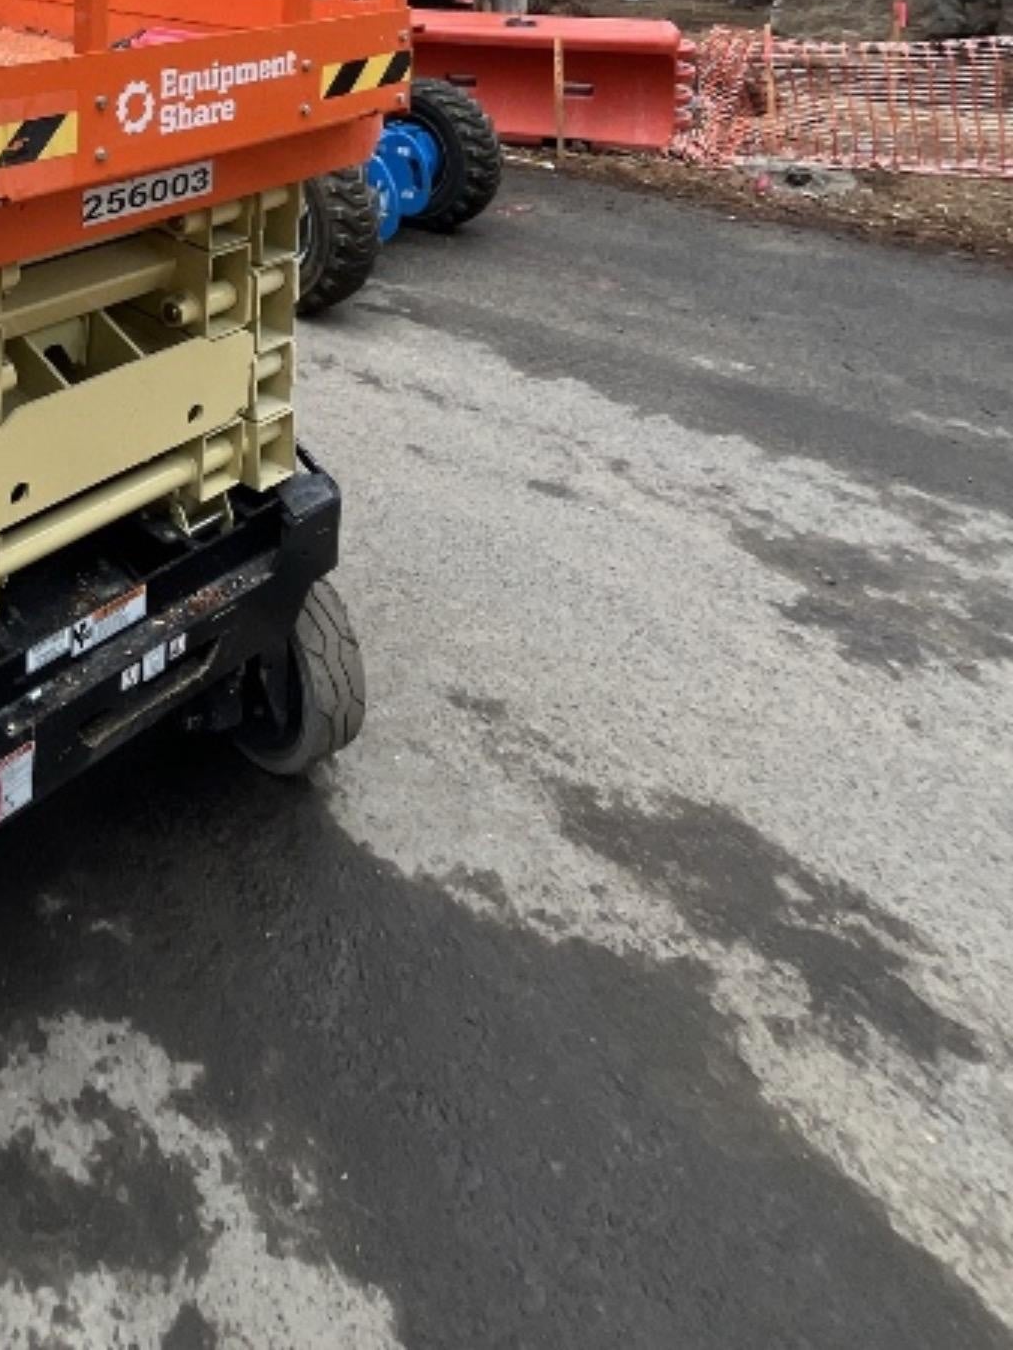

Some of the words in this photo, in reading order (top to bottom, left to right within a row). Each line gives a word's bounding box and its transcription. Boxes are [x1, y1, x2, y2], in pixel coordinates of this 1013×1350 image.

[160, 50, 297, 99] Equipment
[160, 98, 235, 135] Share
[83, 167, 210, 222] 256003
